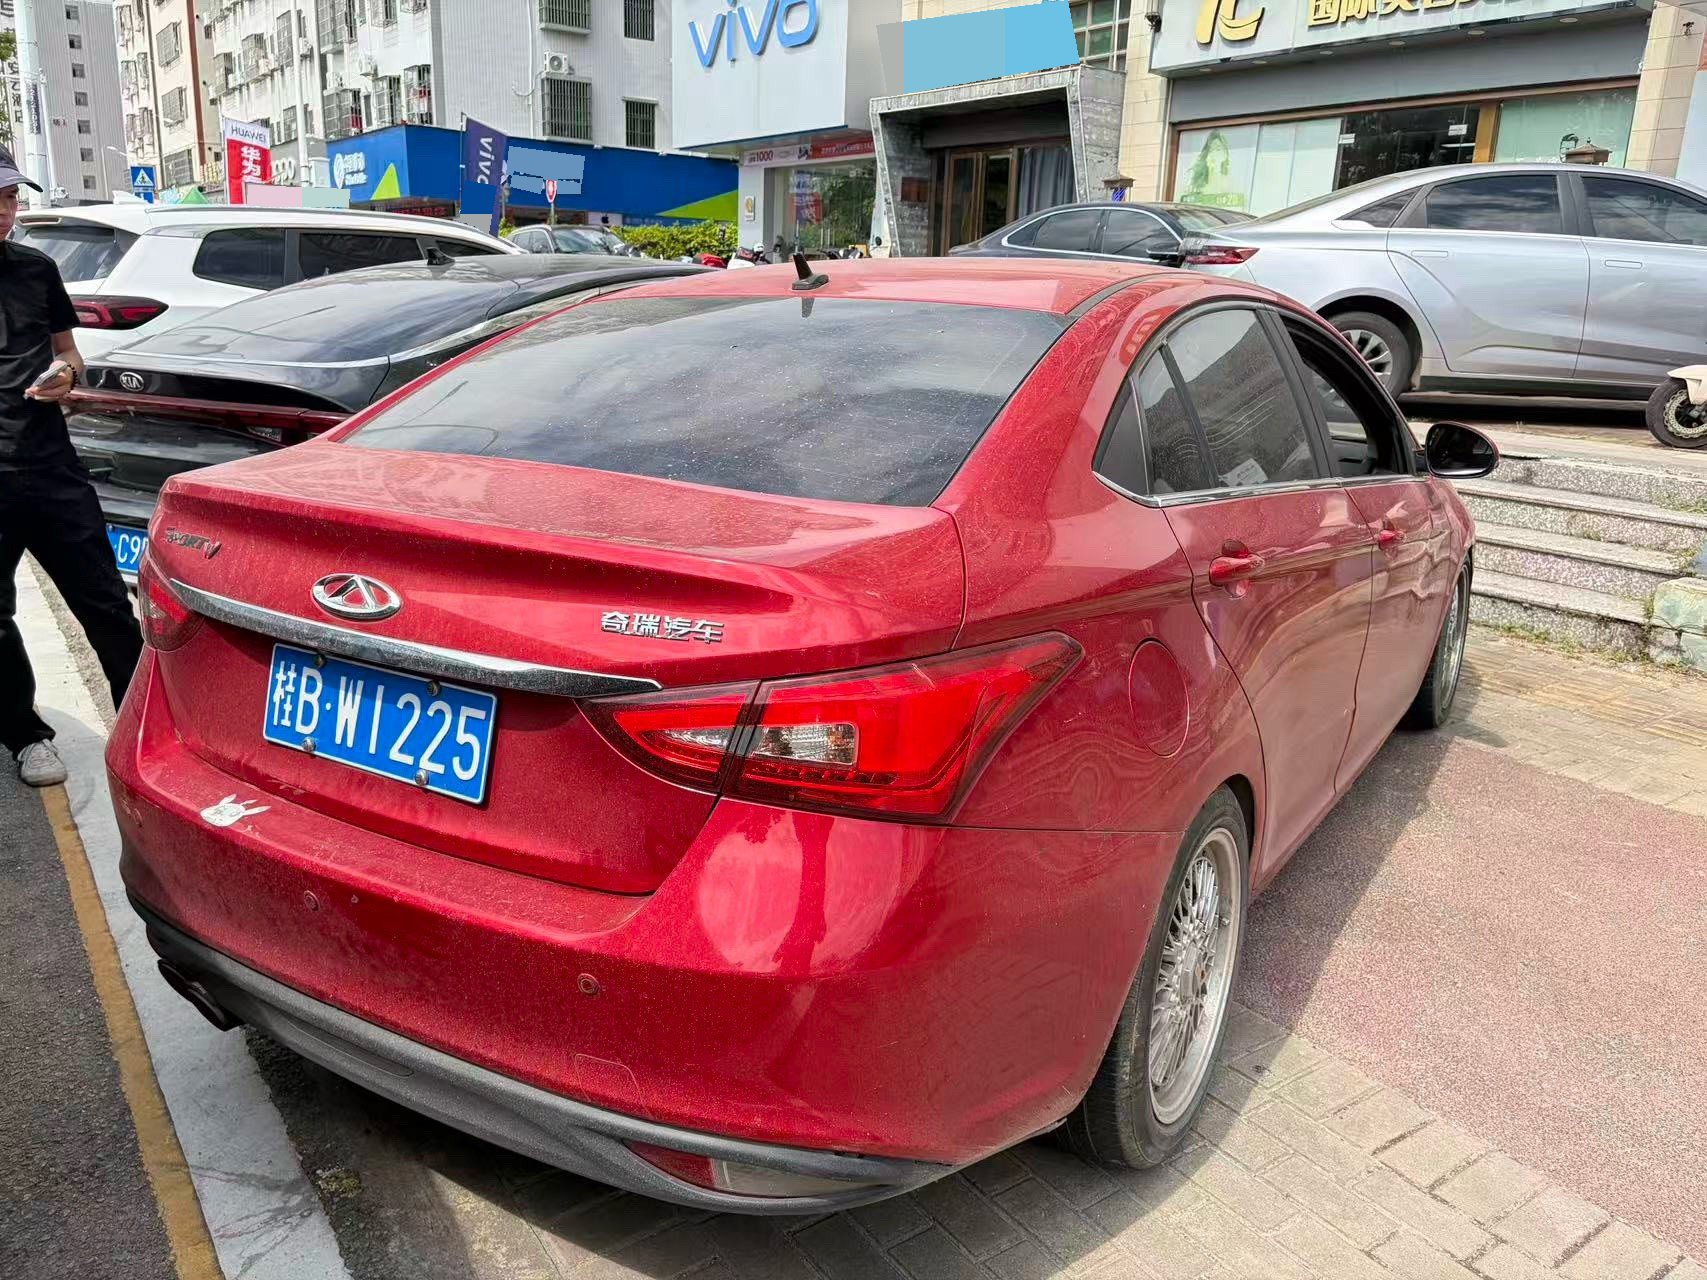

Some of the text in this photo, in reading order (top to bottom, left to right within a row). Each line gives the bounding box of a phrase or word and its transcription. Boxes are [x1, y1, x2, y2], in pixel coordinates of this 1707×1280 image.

[687, 0, 819, 68] vivo
[230, 123, 266, 143] HUAWEI
[121, 376, 141, 389] KIA
[600, 610, 725, 645] 奇瑞汽车
